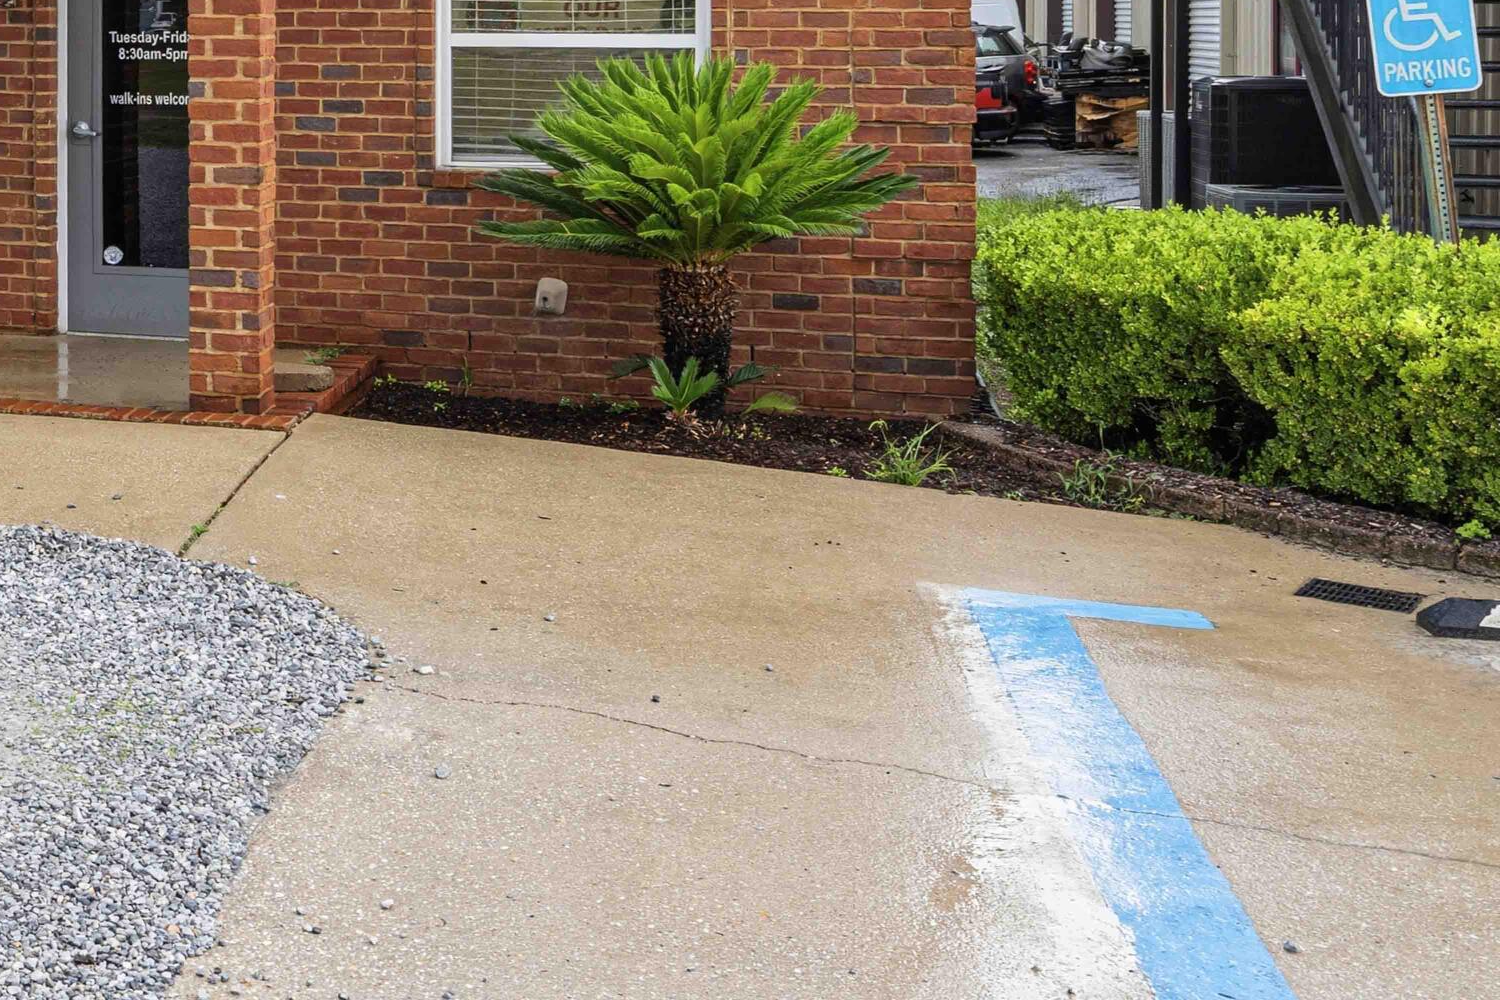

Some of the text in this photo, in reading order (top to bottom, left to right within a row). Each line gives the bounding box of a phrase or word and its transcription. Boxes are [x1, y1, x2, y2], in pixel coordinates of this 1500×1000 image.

[563, 0, 620, 18] OUR
[108, 30, 189, 46] Tuesday-Frid
[1384, 57, 1472, 83] PARKING
[110, 91, 152, 105] walk-ins
